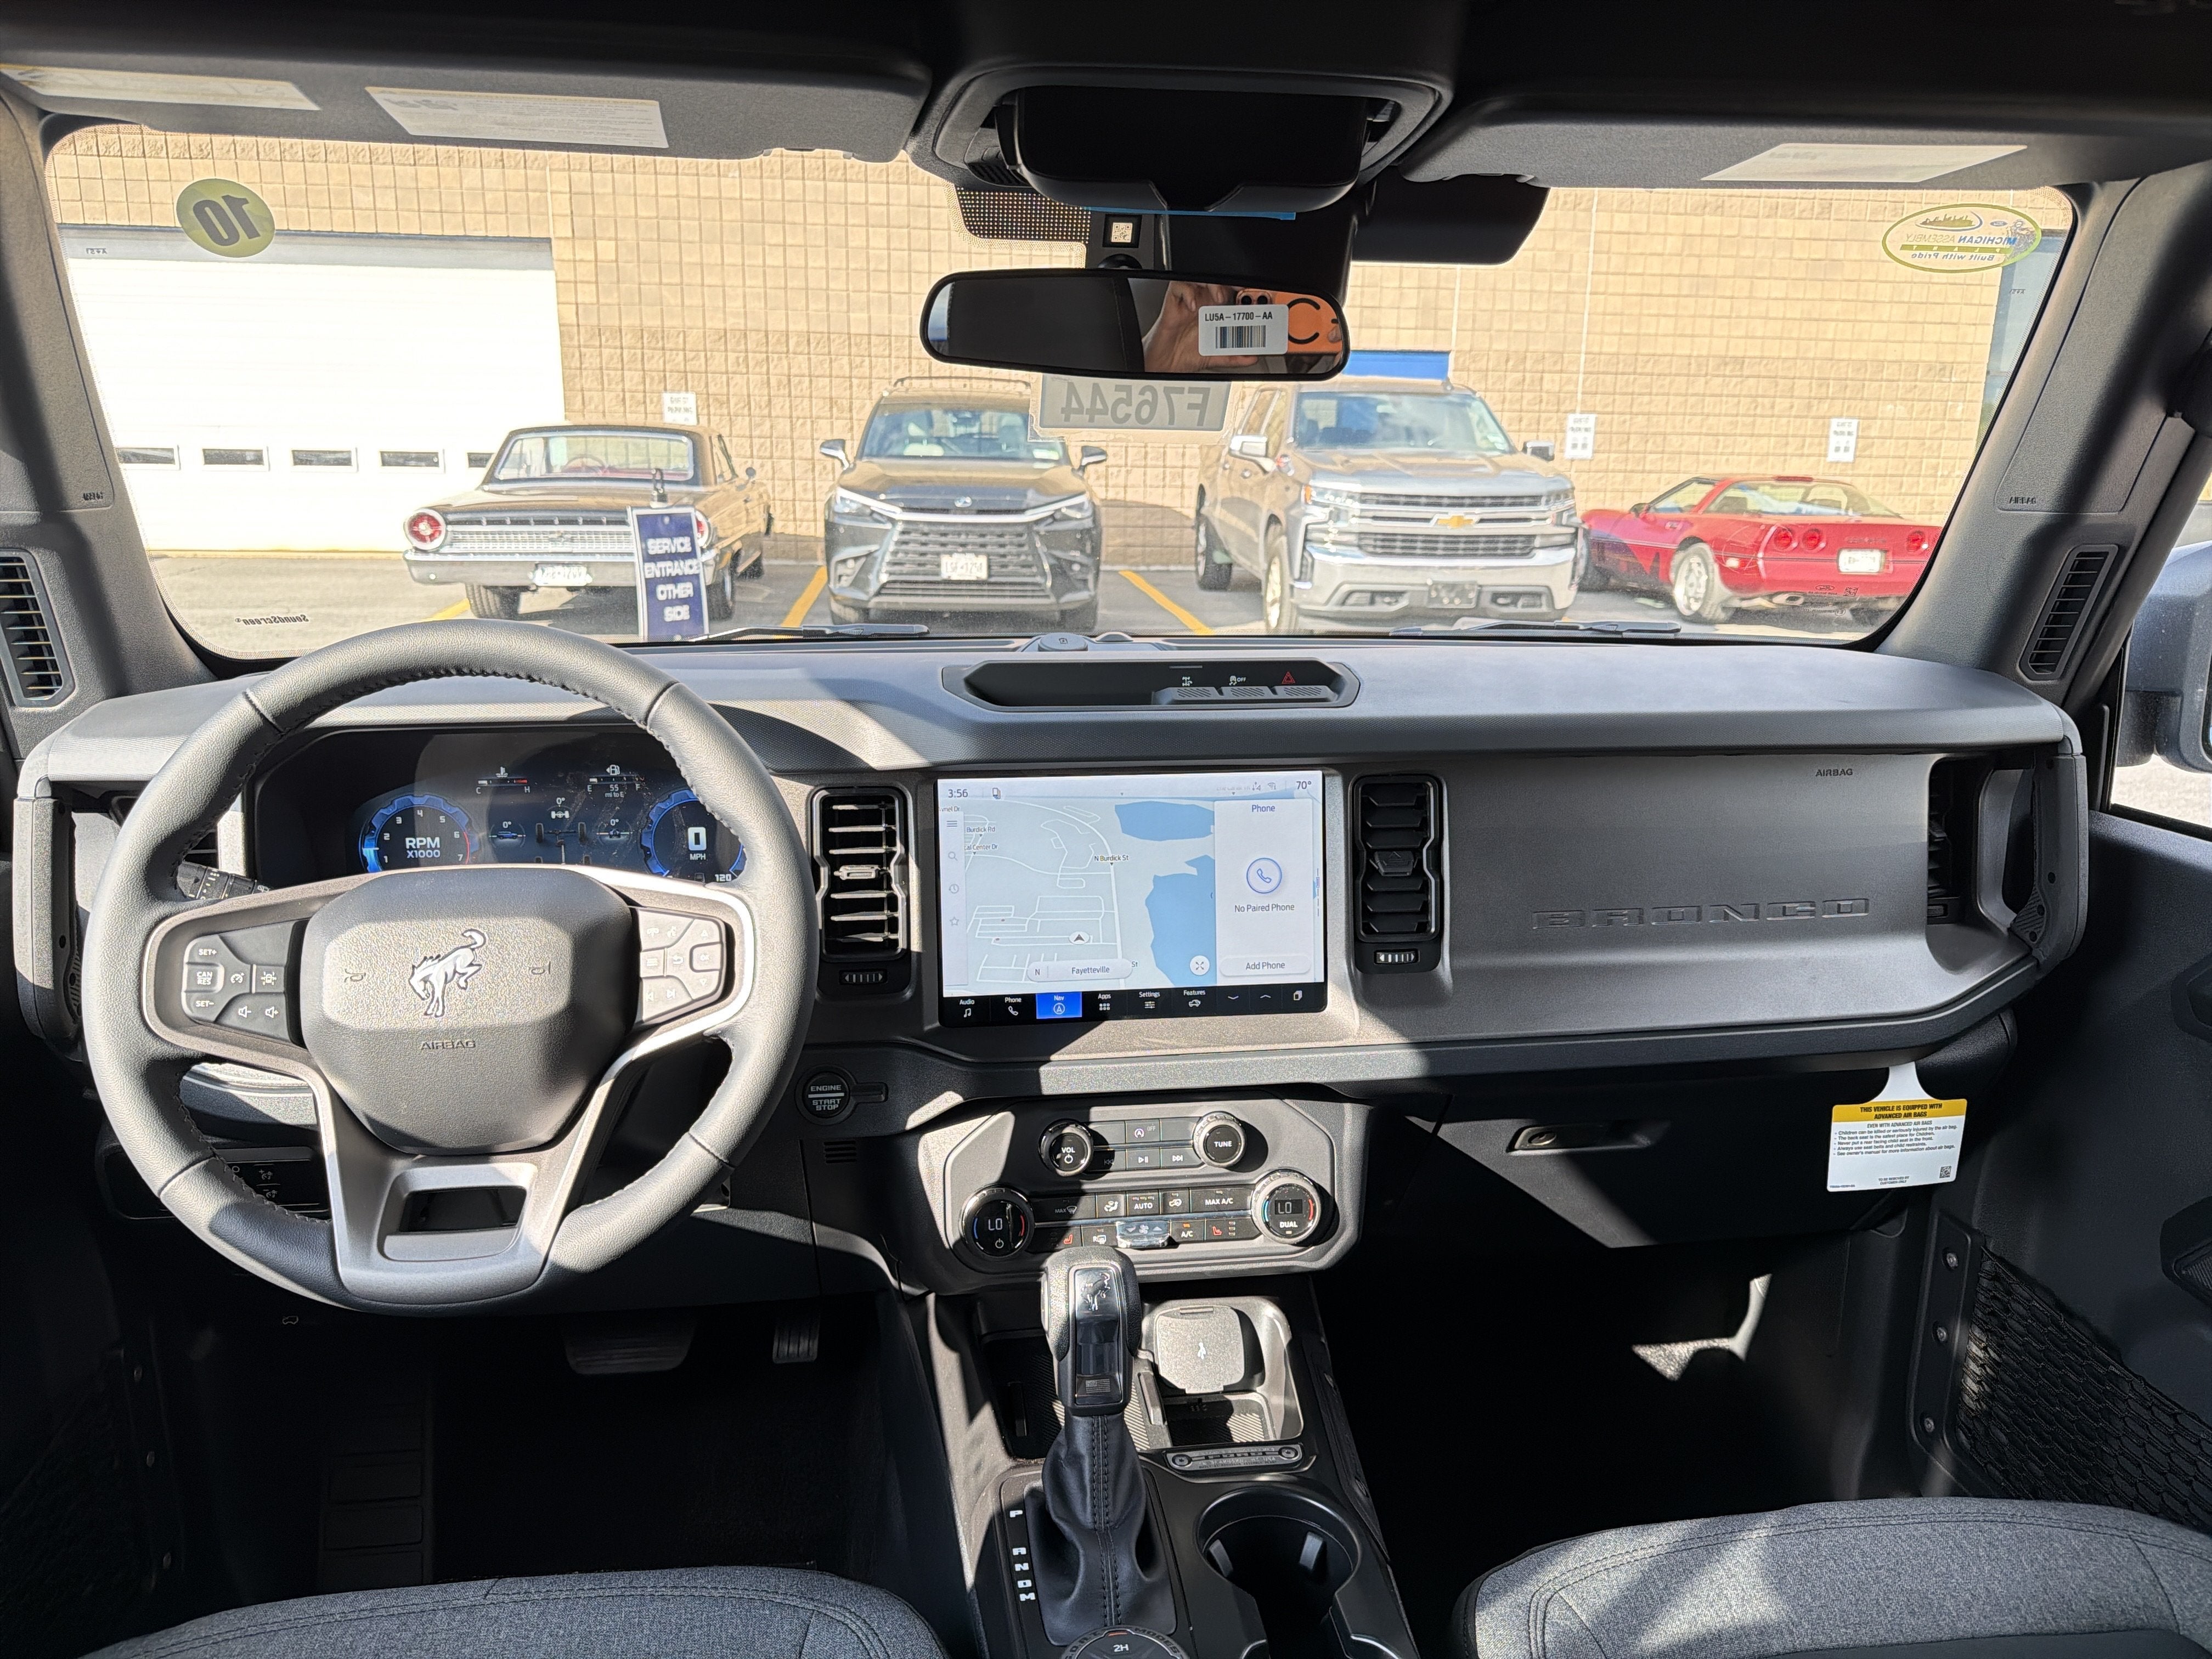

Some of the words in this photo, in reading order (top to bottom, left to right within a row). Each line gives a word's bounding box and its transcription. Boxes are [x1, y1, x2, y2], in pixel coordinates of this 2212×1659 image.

[647, 536, 692, 555] SERVICE
[644, 558, 700, 578] ENTRANCE
[656, 582, 694, 600] OTHER
[664, 605, 690, 622] SIDE
[1815, 768, 1853, 777] AIRBAG
[1296, 781, 1312, 789] 70°
[948, 789, 968, 798] 3:56
[1251, 804, 1276, 812] Phone
[405, 837, 441, 849] RPM
[687, 827, 707, 851] 0
[407, 850, 441, 859] X1000
[714, 874, 732, 882] 120
[1246, 904, 1270, 912] Paired
[1533, 898, 1869, 929] BRONCO
[1071, 966, 1110, 975] Fayetteville
[421, 1040, 476, 1049] AIRBAG
[1278, 1202, 1292, 1214] LO
[988, 1218, 1003, 1231] LO
[1009, 1510, 1023, 1518] P
[1015, 1562, 1029, 1571] N
[1019, 1592, 1036, 1601] M
[1113, 1644, 1129, 1652] 2H
